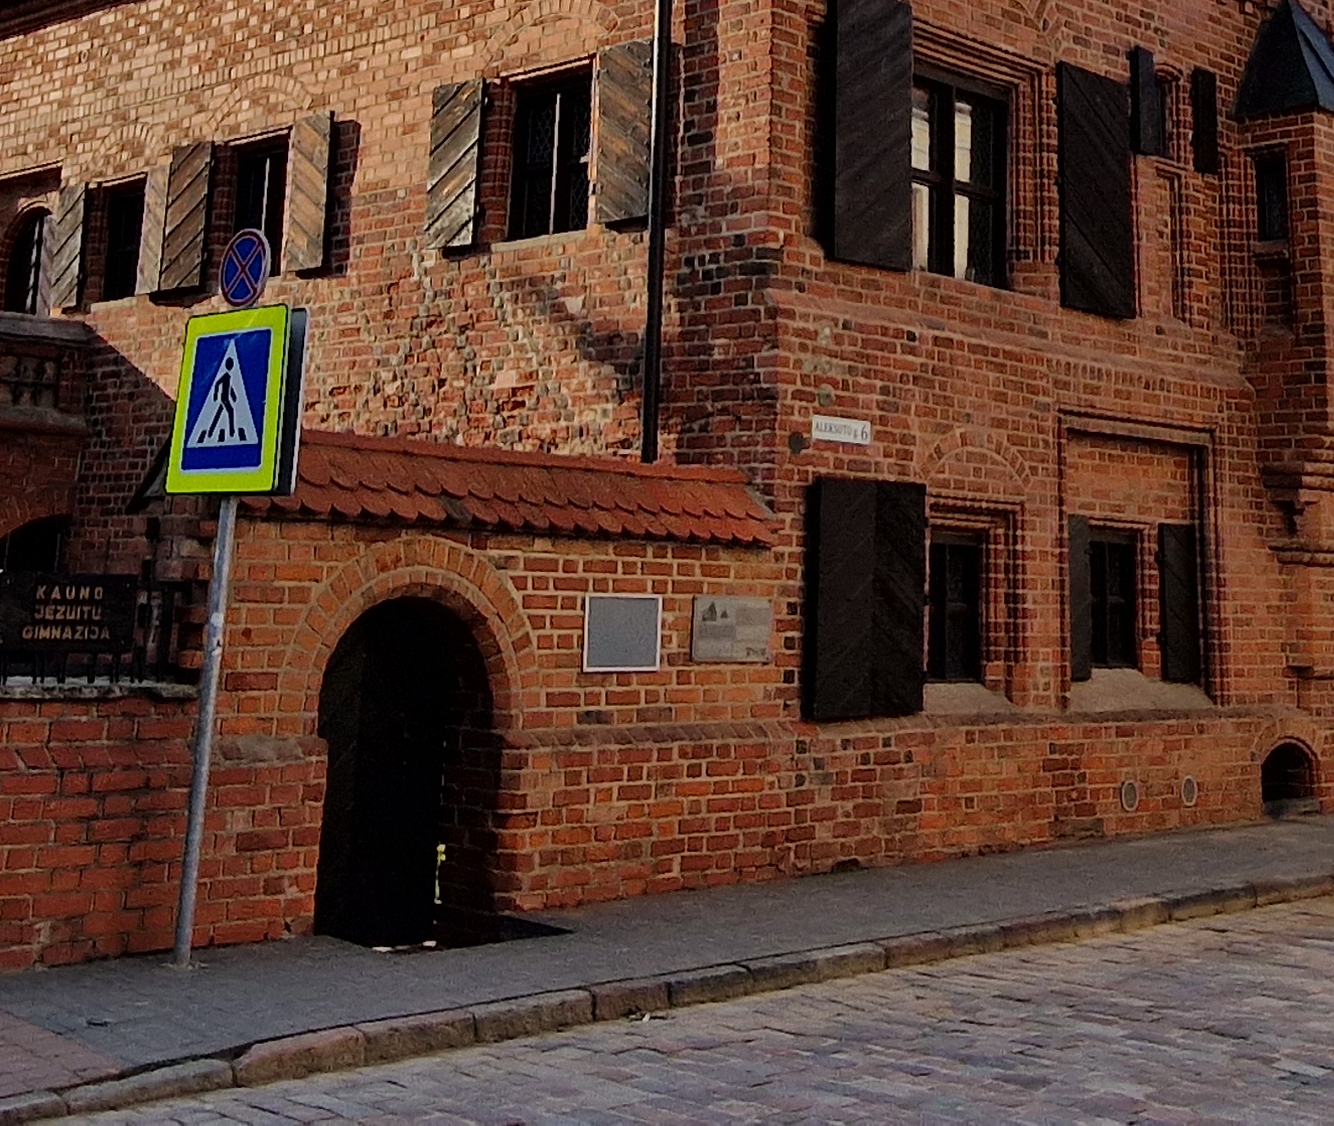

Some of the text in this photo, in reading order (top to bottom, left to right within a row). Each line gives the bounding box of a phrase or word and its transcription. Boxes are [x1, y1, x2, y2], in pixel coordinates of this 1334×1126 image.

[861, 425, 868, 441] 6
[36, 585, 103, 600] KAUNO
[21, 624, 111, 640] GIMNAZIJA
